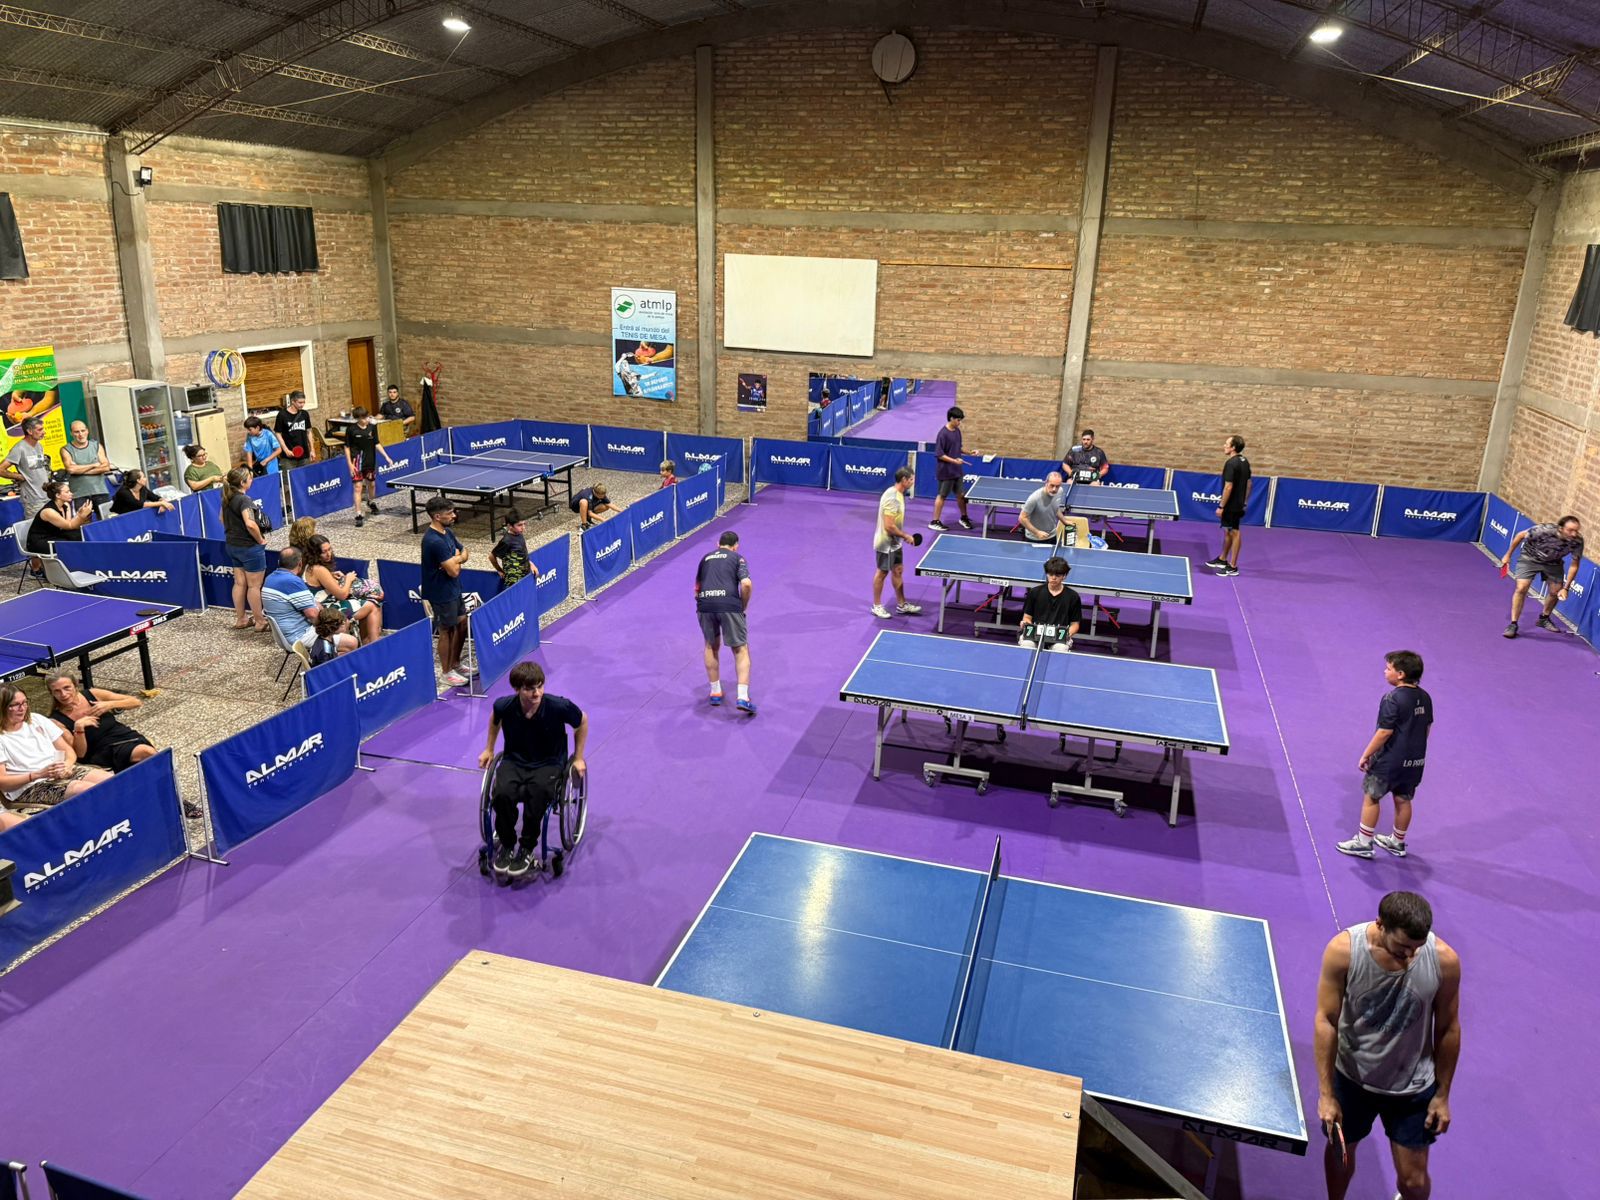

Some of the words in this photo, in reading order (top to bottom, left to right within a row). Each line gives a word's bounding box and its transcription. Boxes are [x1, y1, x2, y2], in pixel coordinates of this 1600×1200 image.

[640, 299, 672, 312] atmlp
[470, 437, 506, 448] ALMAR
[532, 436, 570, 445] ALMAR
[607, 443, 645, 453] ALMAR
[770, 455, 811, 464] ALMAR
[845, 464, 887, 474] ALMAR
[307, 477, 341, 493] ALMAR
[686, 491, 708, 507] ALMAR
[1298, 498, 1350, 510] ALMAR
[640, 510, 664, 529] ALMAR
[1404, 508, 1457, 520] ALMAR
[595, 538, 622, 559] ALMAR
[95, 570, 167, 579] ALMAR
[536, 568, 557, 586] MAR
[705, 589, 726, 598] PAMPA
[491, 611, 525, 643] ALMAR
[1026, 625, 1034, 637] 7
[1058, 629, 1066, 640] 7
[356, 666, 406, 699] LMAR
[949, 712, 967, 720] MESA
[245, 732, 323, 784] ALMAR
[24, 819, 132, 889] ALMAR
[1181, 1120, 1279, 1150] ALMAR
